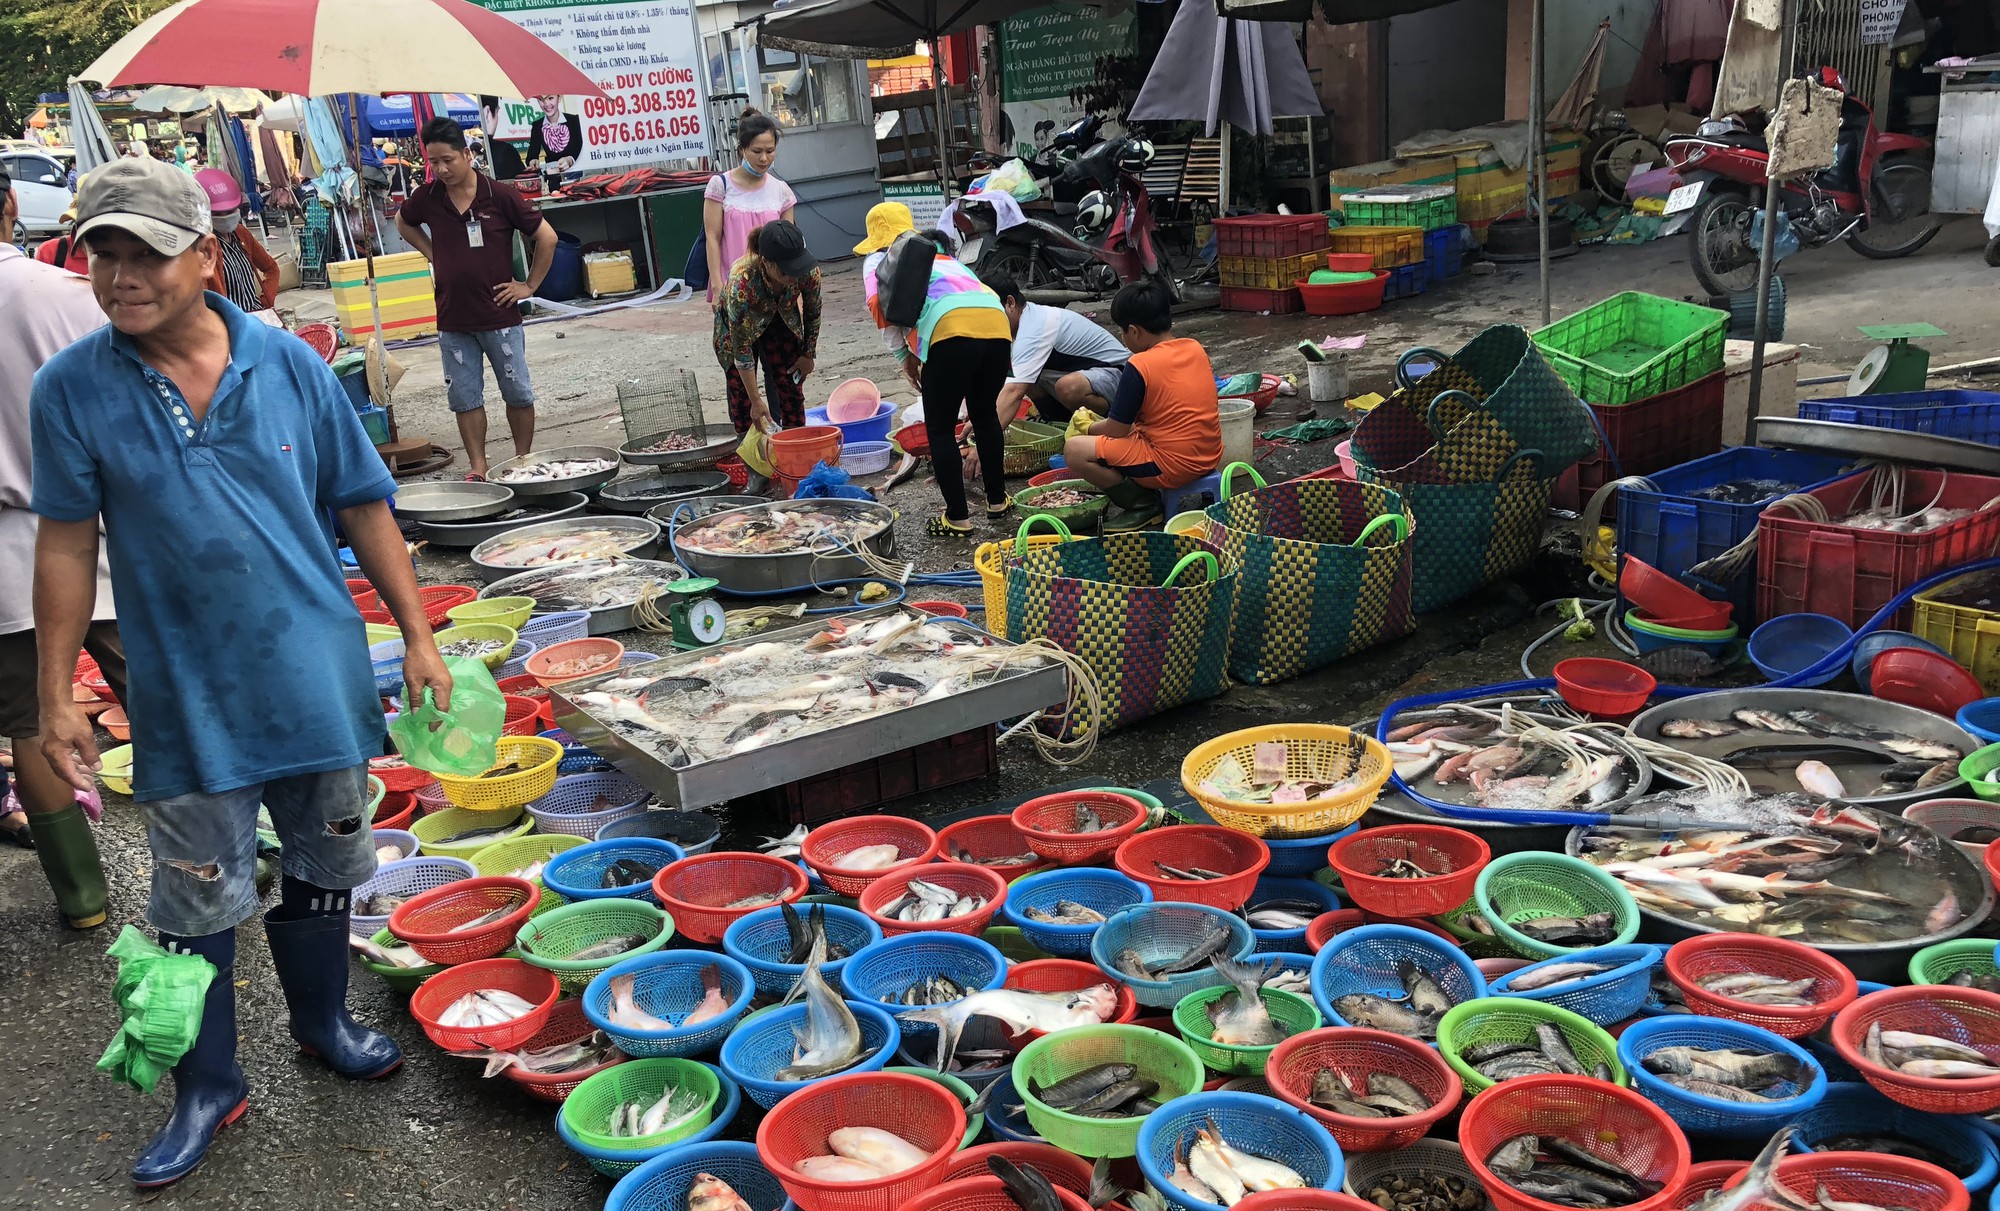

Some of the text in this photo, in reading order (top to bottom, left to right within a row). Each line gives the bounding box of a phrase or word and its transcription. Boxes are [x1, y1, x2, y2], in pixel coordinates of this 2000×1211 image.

[504, 0, 523, 9] BIỆT
[1862, 0, 1888, 9] CHO
[587, 11, 602, 21] suất
[669, 6, 689, 18] tháng
[1862, 10, 1895, 23] PHÒNG
[575, 28, 600, 39] Không
[620, 25, 636, 37] định
[637, 24, 651, 34] nhà
[1003, 19, 1030, 32] Địa
[578, 41, 646, 55] Không sao kê lương
[1005, 39, 1036, 51] Trao
[1041, 33, 1073, 47] Trọn
[609, 57, 632, 67] CMND
[1005, 60, 1030, 72] NGÂN
[1032, 56, 1056, 69] HÀNG
[1073, 50, 1092, 63] TRỢ
[597, 66, 694, 91] ẤN: DUY CƯỜNG
[1027, 71, 1052, 84] CÔNG
[1053, 70, 1065, 81] TY
[1033, 85, 1049, 94] nhanh
[583, 88, 697, 119] 0909.308.592
[588, 114, 701, 147] 0976.616.056
[590, 140, 704, 161] Hỗ trợ vay được 4 Ngân Hàng
[885, 185, 898, 194] NGÂN
[899, 184, 913, 193] HÀNG
[922, 184, 933, 193] TRỢ
